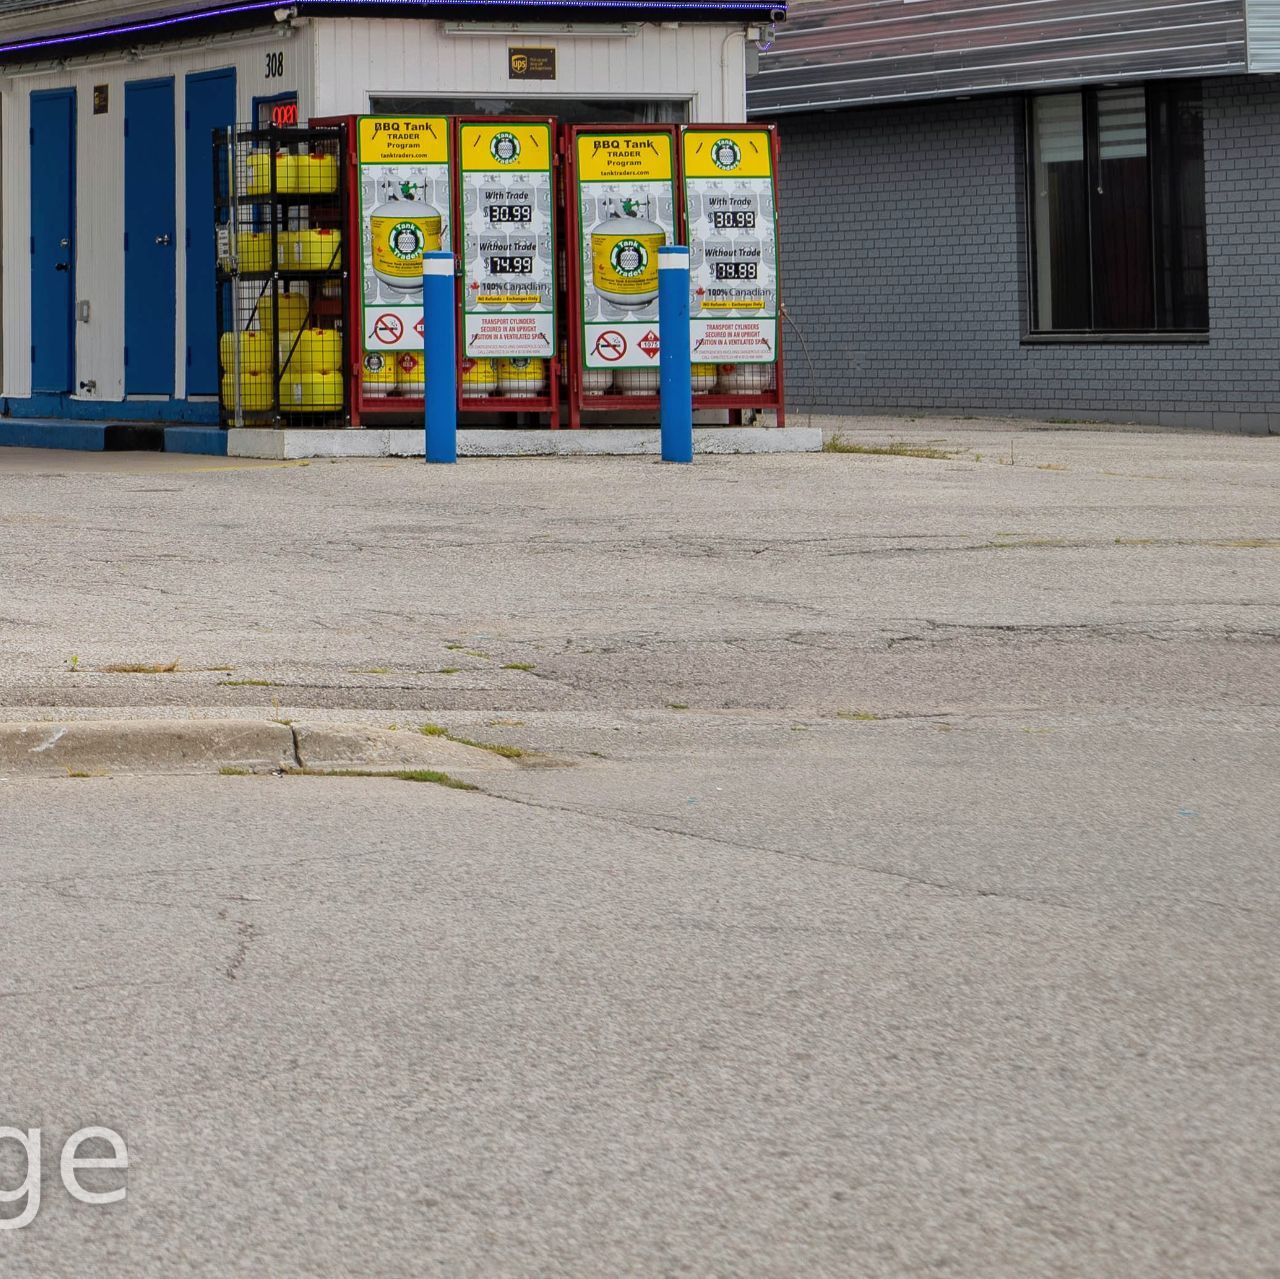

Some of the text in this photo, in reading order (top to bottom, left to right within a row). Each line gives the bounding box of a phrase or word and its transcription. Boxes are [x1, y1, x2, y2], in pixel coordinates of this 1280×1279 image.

[265, 51, 283, 78] 308
[272, 105, 298, 128] open
[375, 122, 432, 131] BBQ Tank
[593, 140, 654, 149] BBQ Tank
[485, 192, 529, 200] With Trade
[709, 198, 727, 206] With
[396, 222, 415, 231] Tank
[480, 242, 537, 251] Without Trade
[618, 239, 639, 248] Tank
[705, 248, 761, 257] Without Trade
[482, 282, 547, 291] 100% Canadian
[708, 288, 771, 296] 100% Canadian
